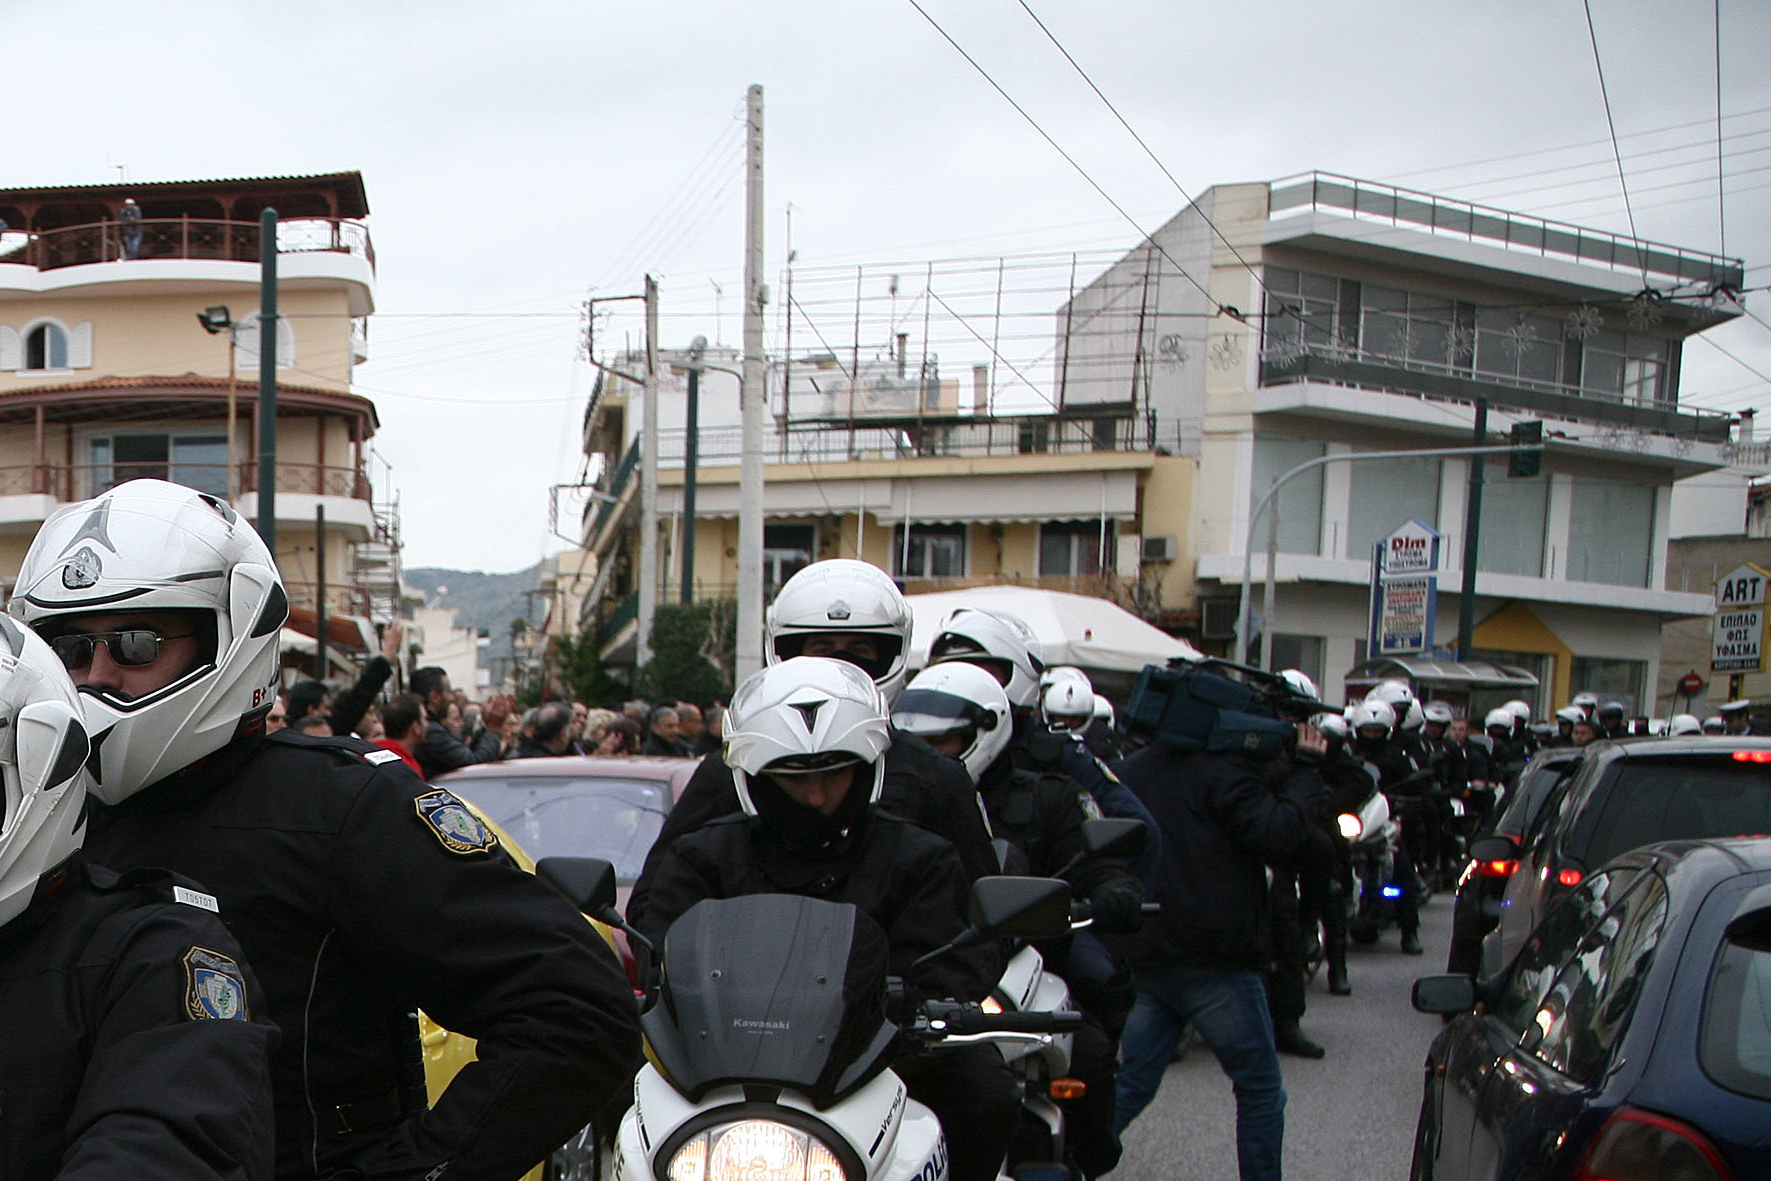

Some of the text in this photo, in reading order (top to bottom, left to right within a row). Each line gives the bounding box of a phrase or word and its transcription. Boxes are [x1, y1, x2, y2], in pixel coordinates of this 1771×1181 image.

[1722, 577, 1760, 602] ART
[1720, 613, 1757, 629] ΕΠΙΠΛΟ
[1727, 630, 1749, 641] ΦΩΣ
[1715, 642, 1757, 657] ΥΦΑΣΜΑ
[733, 1019, 789, 1030] Kawasaki
[881, 1084, 903, 1132] Versys
